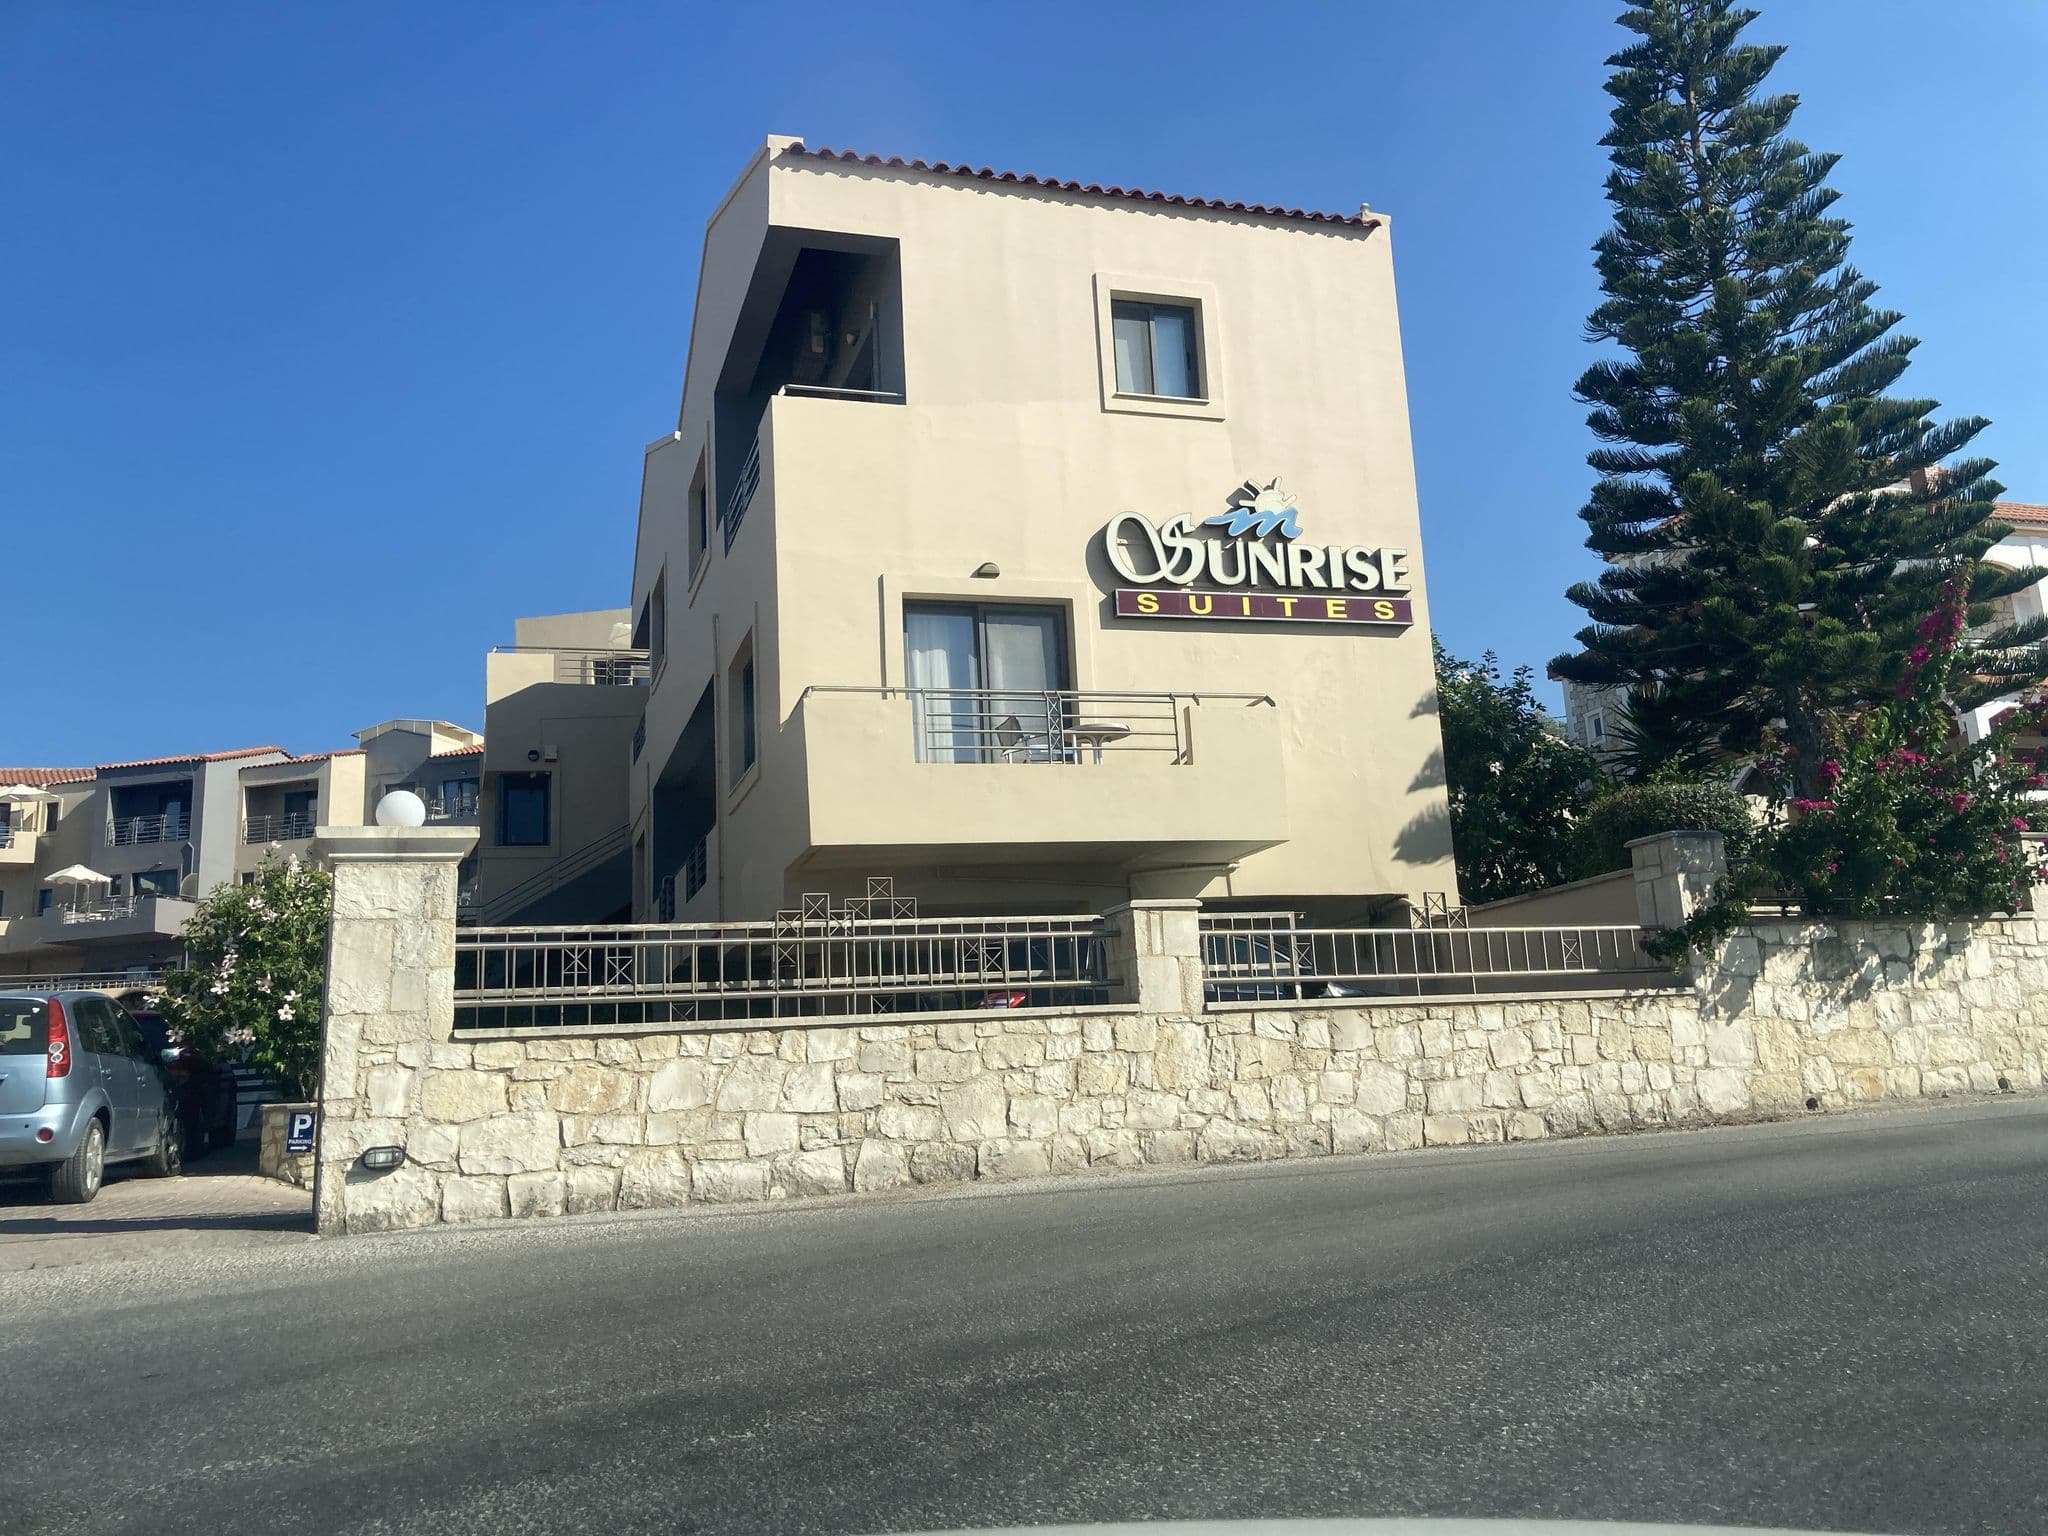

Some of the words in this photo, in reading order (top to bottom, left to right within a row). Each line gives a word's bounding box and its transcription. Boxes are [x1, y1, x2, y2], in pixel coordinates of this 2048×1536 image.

[1106, 511, 1412, 591] SUNRISE
[1136, 593, 1396, 620] SUITES
[293, 1113, 312, 1138] P
